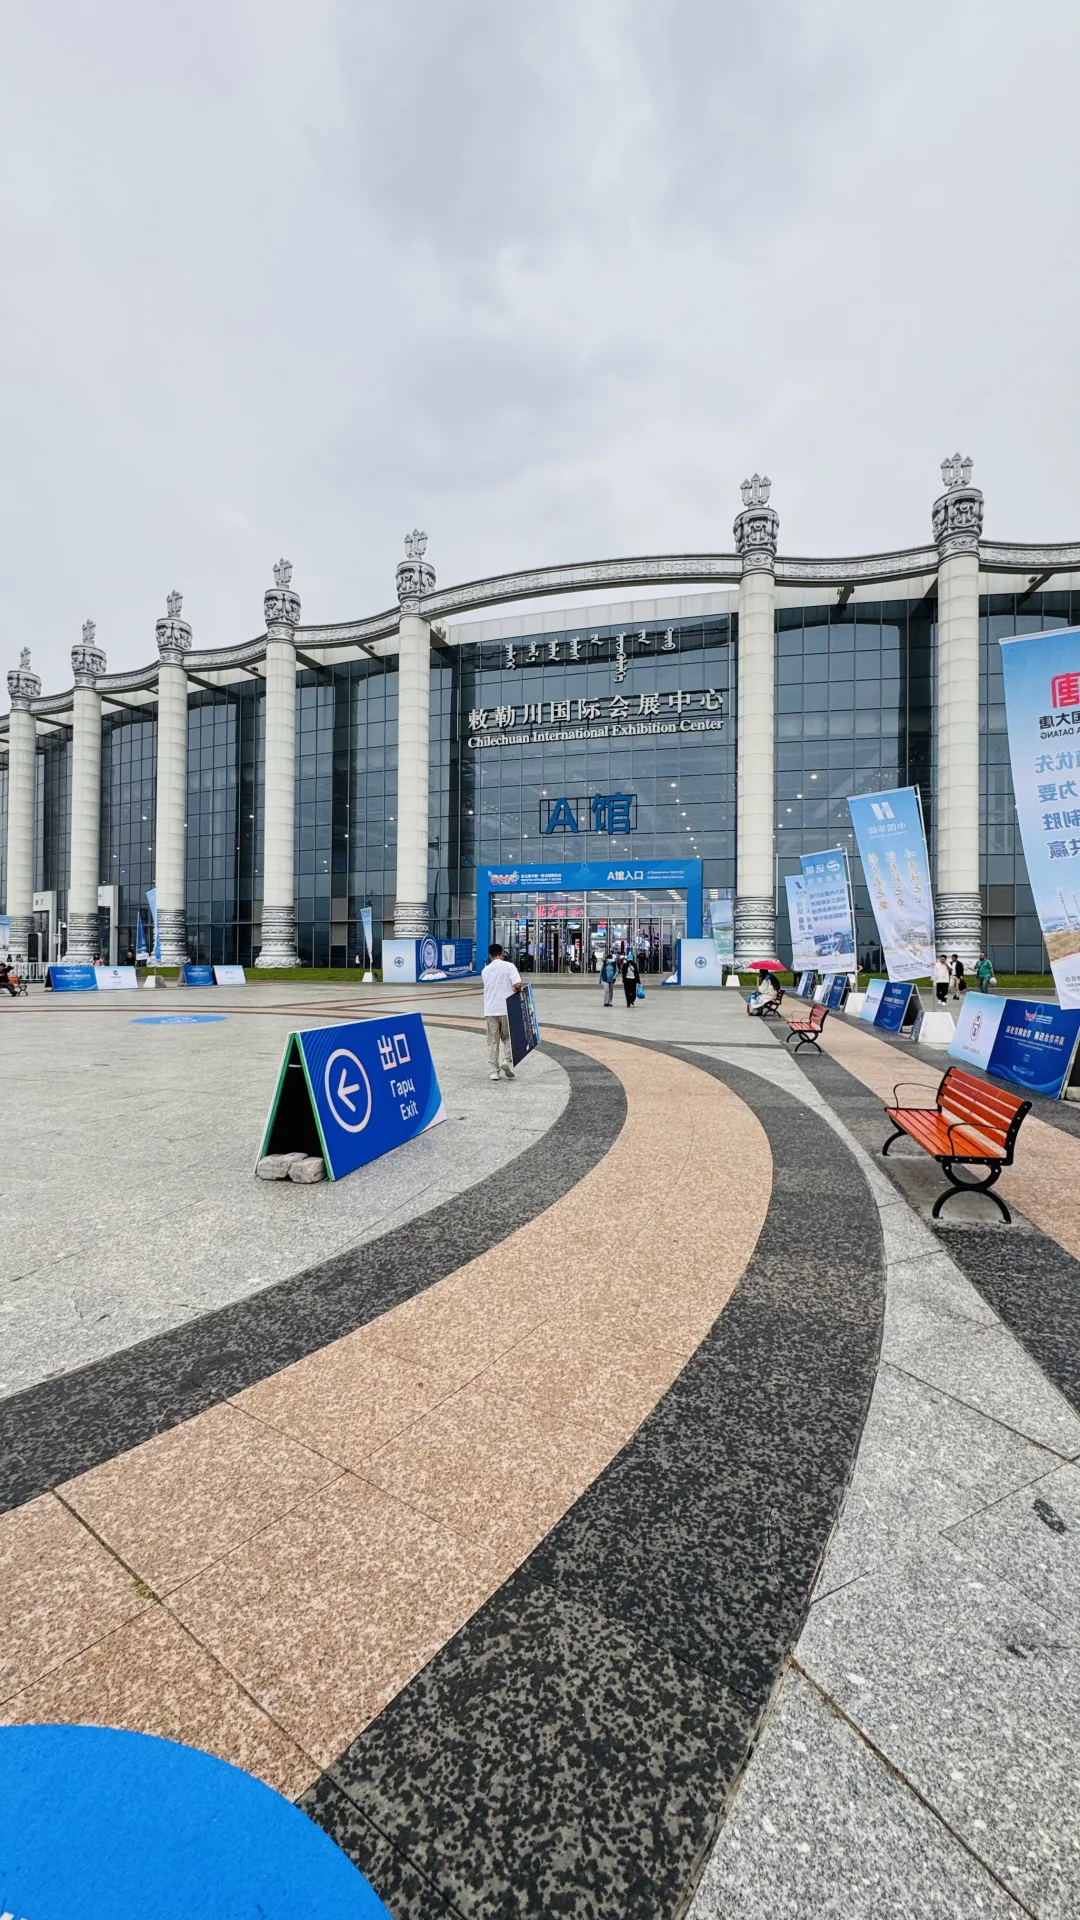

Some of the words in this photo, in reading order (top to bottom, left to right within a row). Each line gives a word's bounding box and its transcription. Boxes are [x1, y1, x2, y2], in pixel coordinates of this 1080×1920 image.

[468, 688, 724, 731] 敕勒川国际会展中心
[468, 734, 530, 749] Chilechuan
[532, 725, 609, 742] International
[612, 722, 677, 737] Exhibition
[679, 719, 723, 732] Center
[607, 870, 643, 882] A馆入口
[376, 1033, 411, 1071] 出口
[389, 1076, 416, 1098] Гарц
[399, 1100, 419, 1121] Exit
